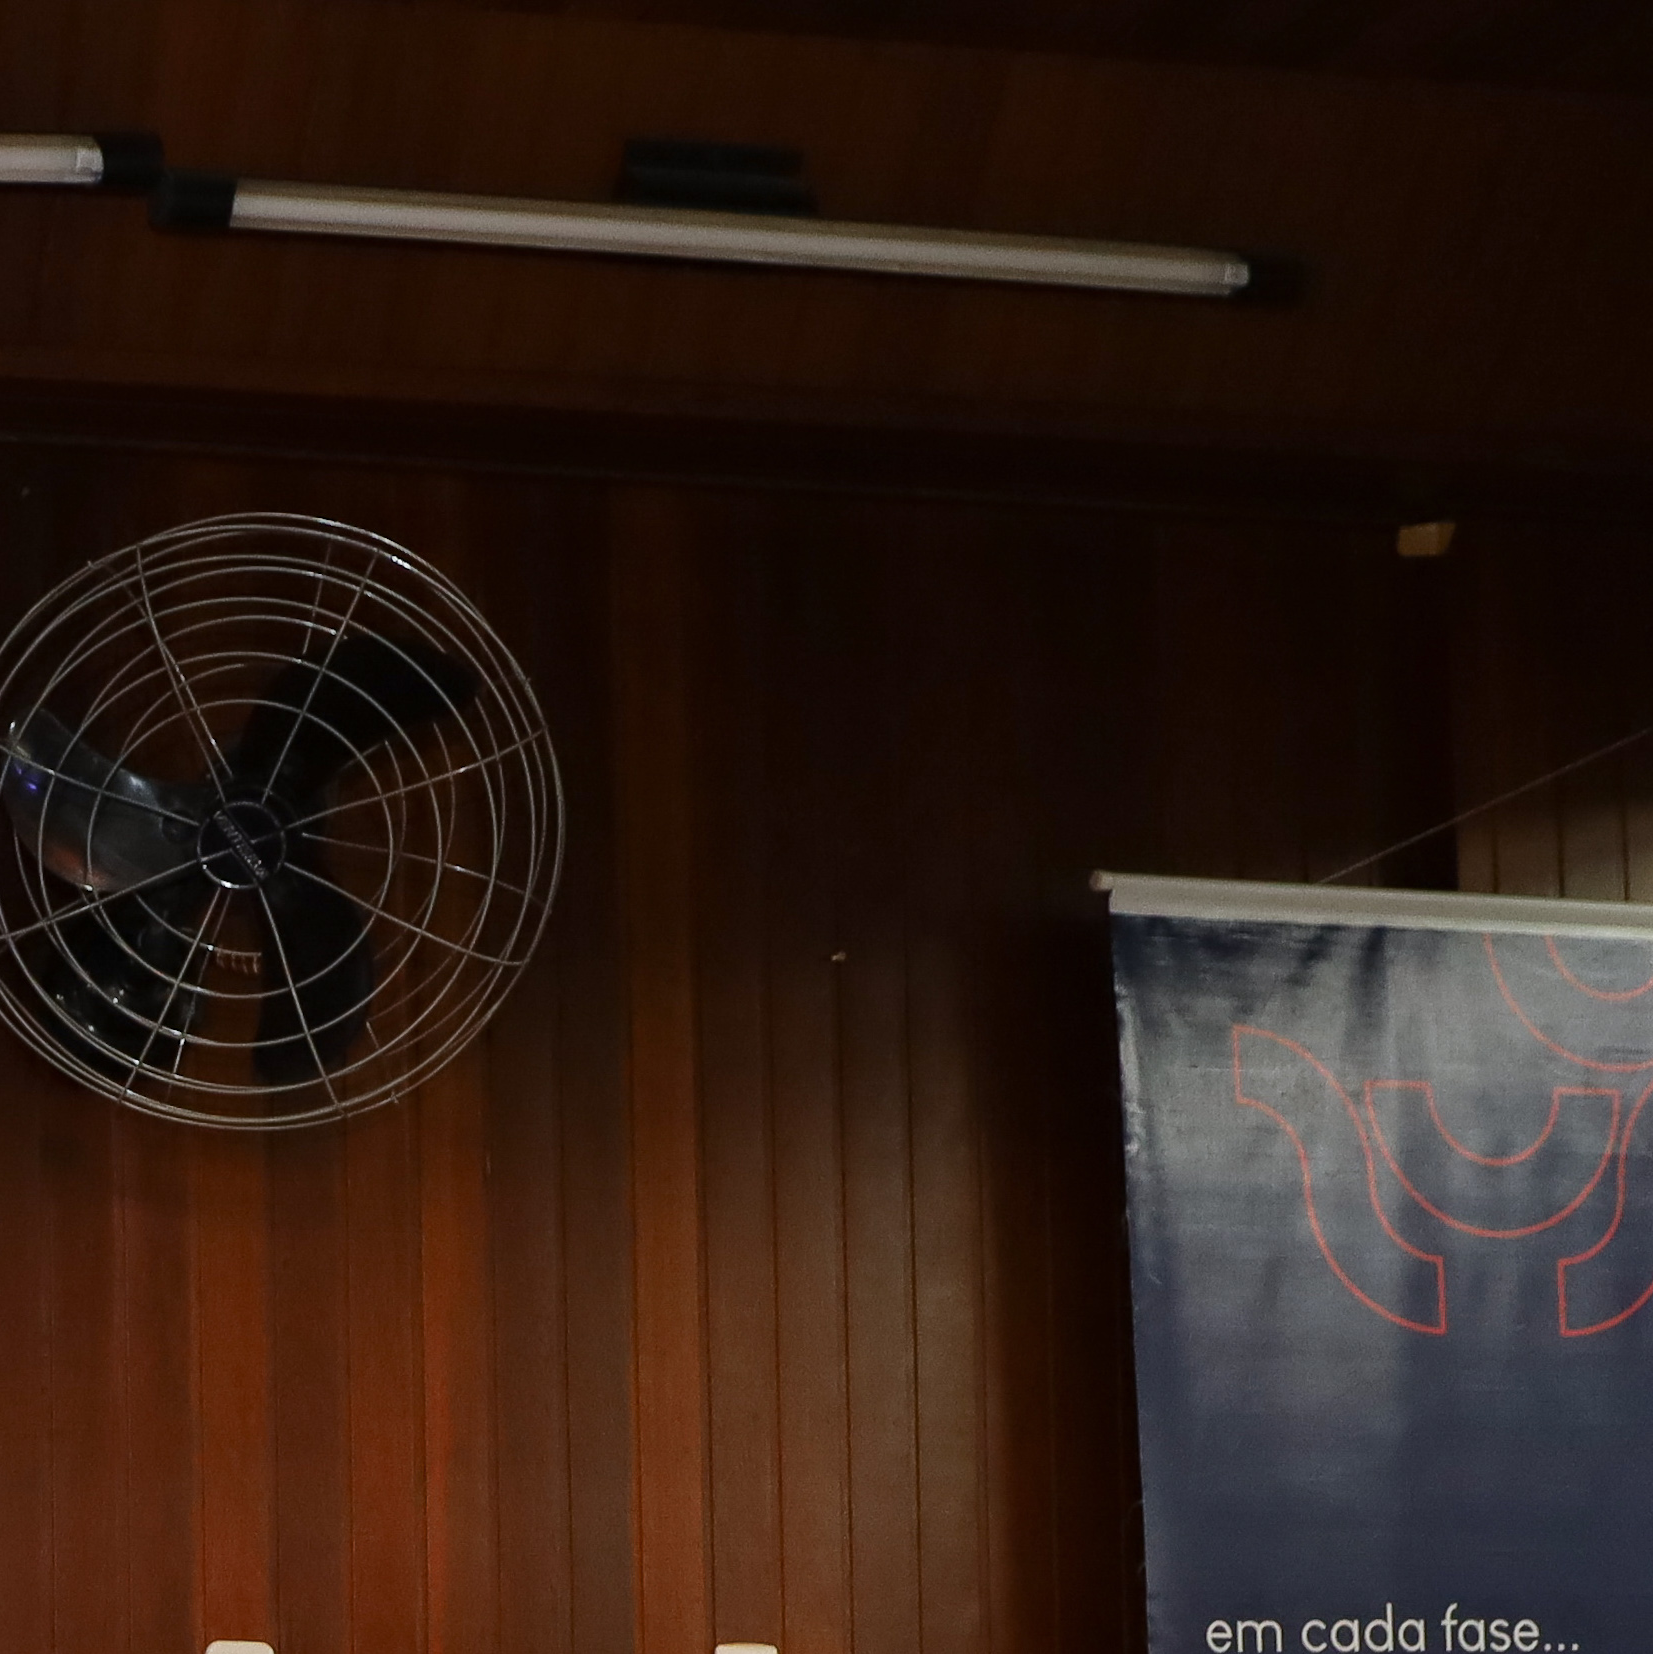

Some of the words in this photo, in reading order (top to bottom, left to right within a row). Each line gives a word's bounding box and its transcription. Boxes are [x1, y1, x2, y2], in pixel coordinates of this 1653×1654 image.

[1206, 1617, 1283, 1653] em
[1301, 1602, 1426, 1653] cada
[1441, 1602, 1580, 1653] fase...
